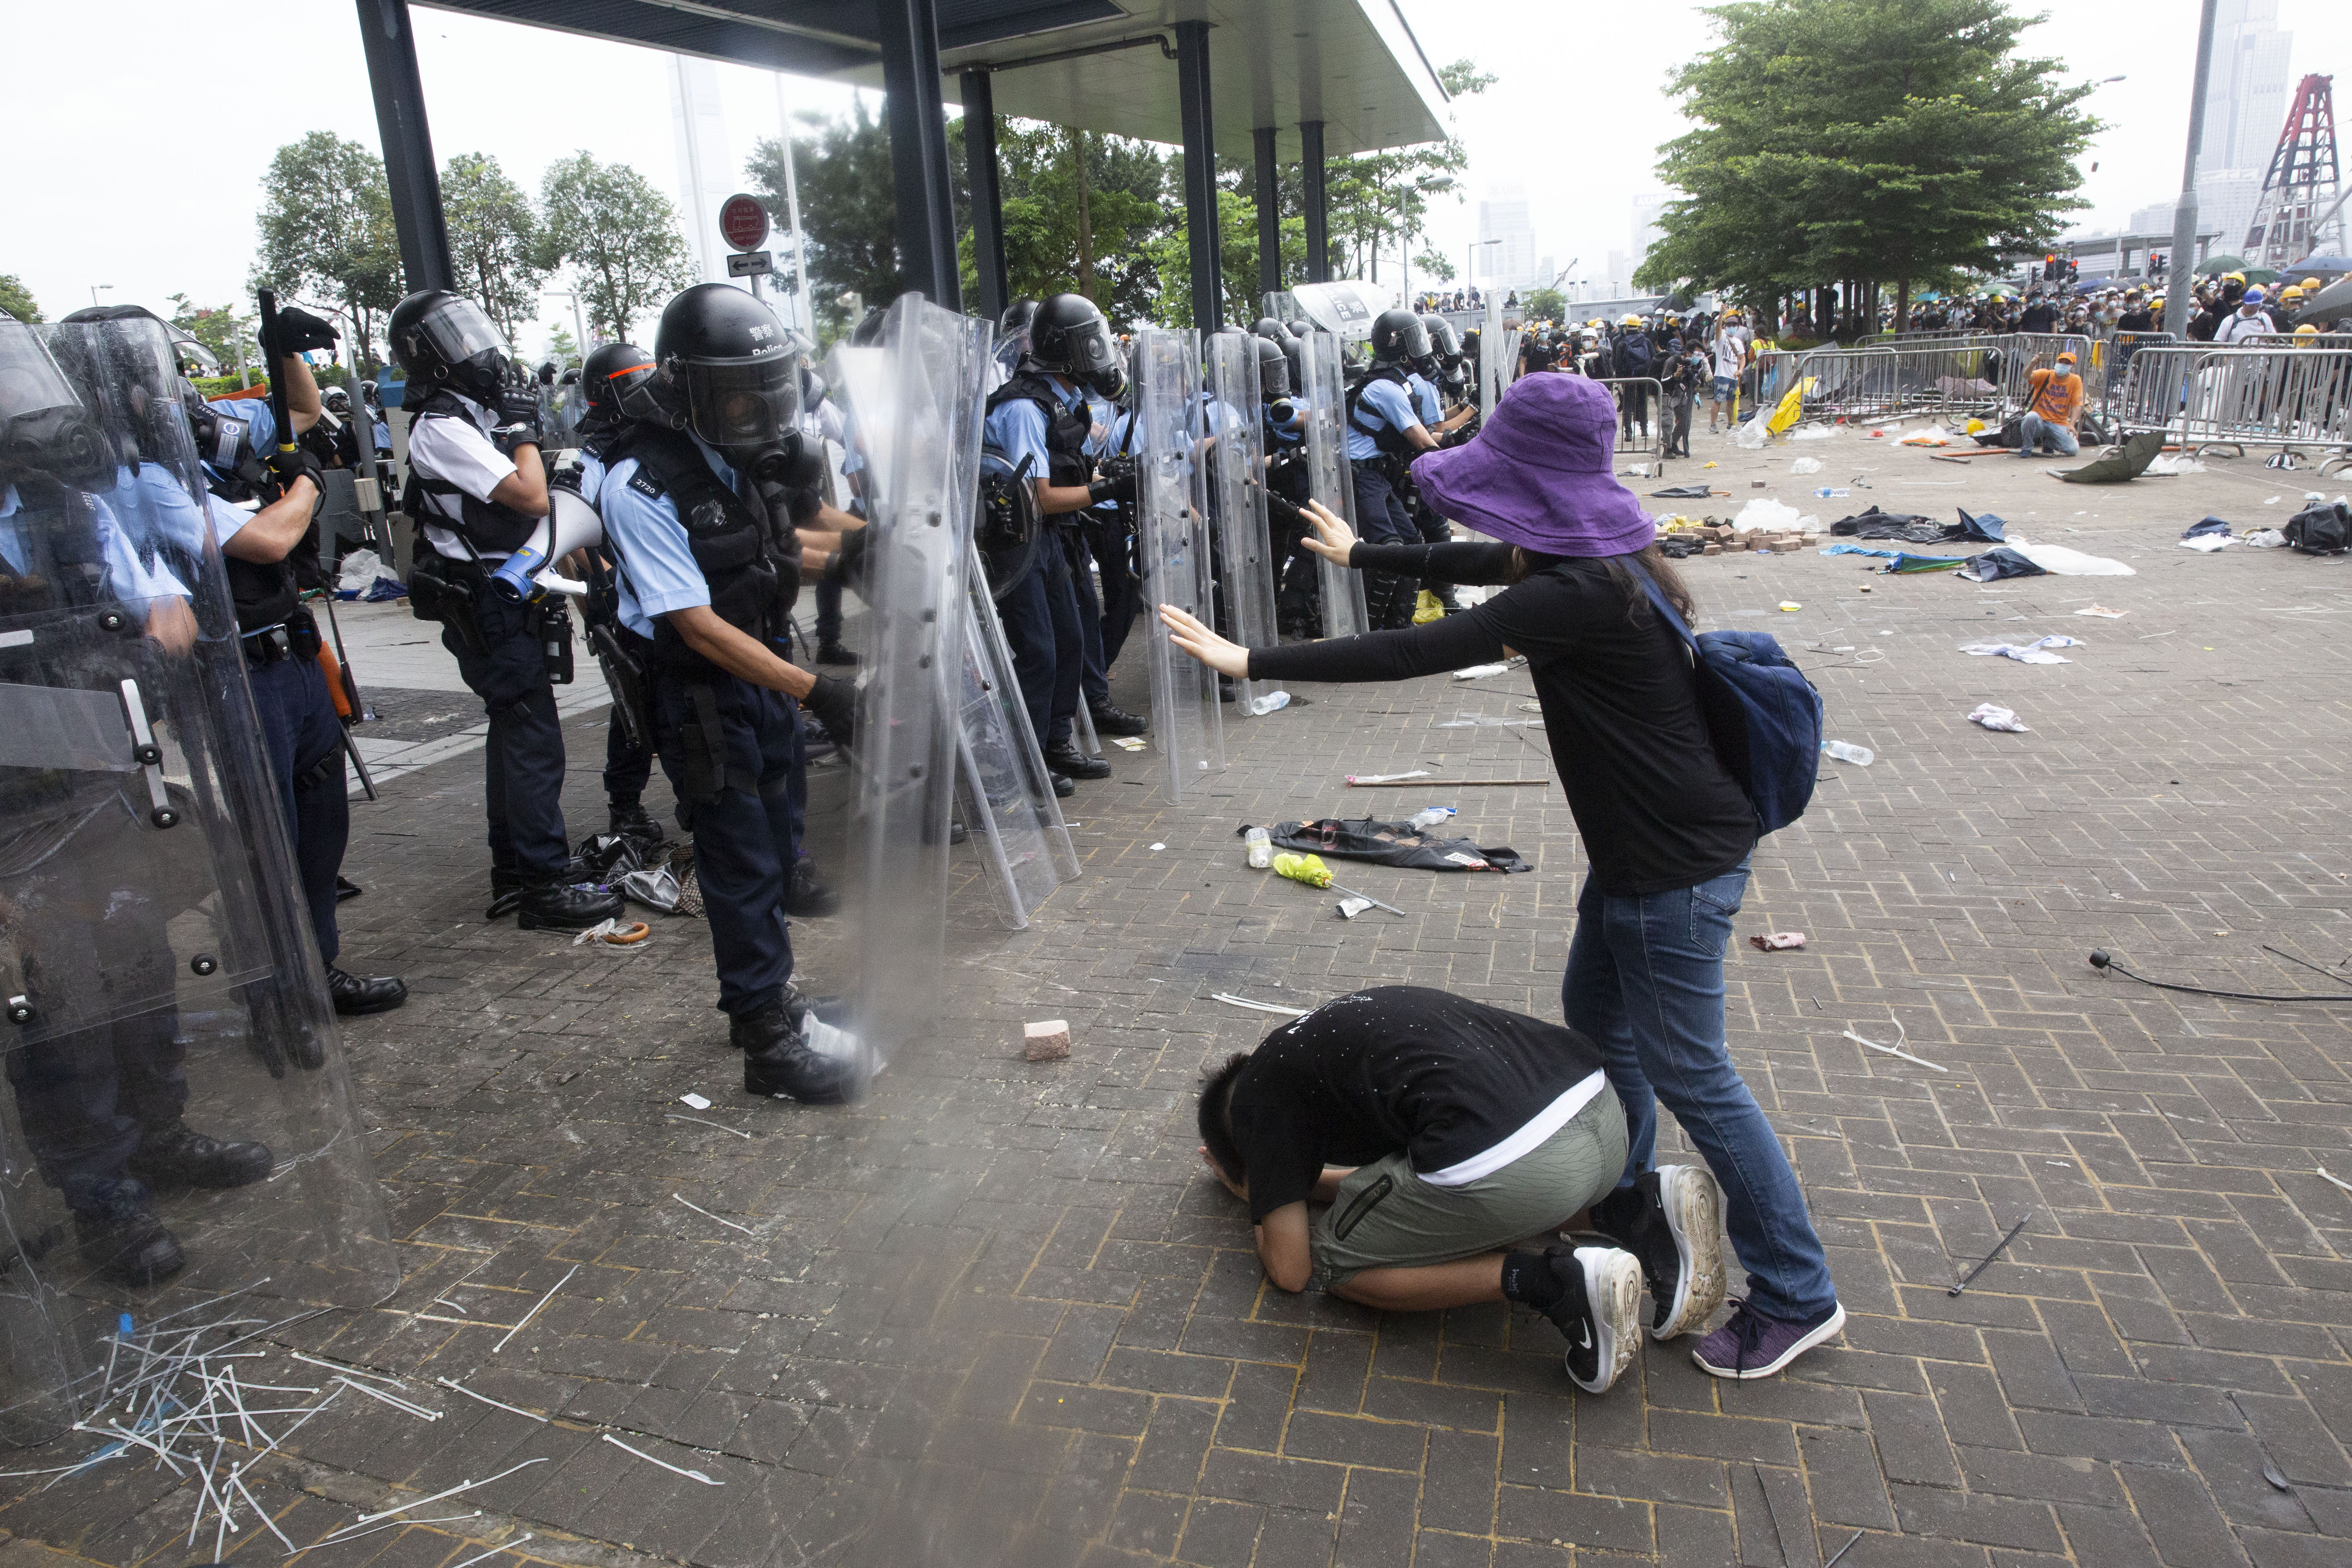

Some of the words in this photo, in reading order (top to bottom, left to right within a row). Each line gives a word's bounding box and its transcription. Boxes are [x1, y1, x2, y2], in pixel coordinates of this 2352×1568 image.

[1502, 185, 1525, 196] UBS
[1637, 196, 1655, 206] AXA
[748, 324, 775, 342] 警察
[635, 479, 655, 494] 2720
